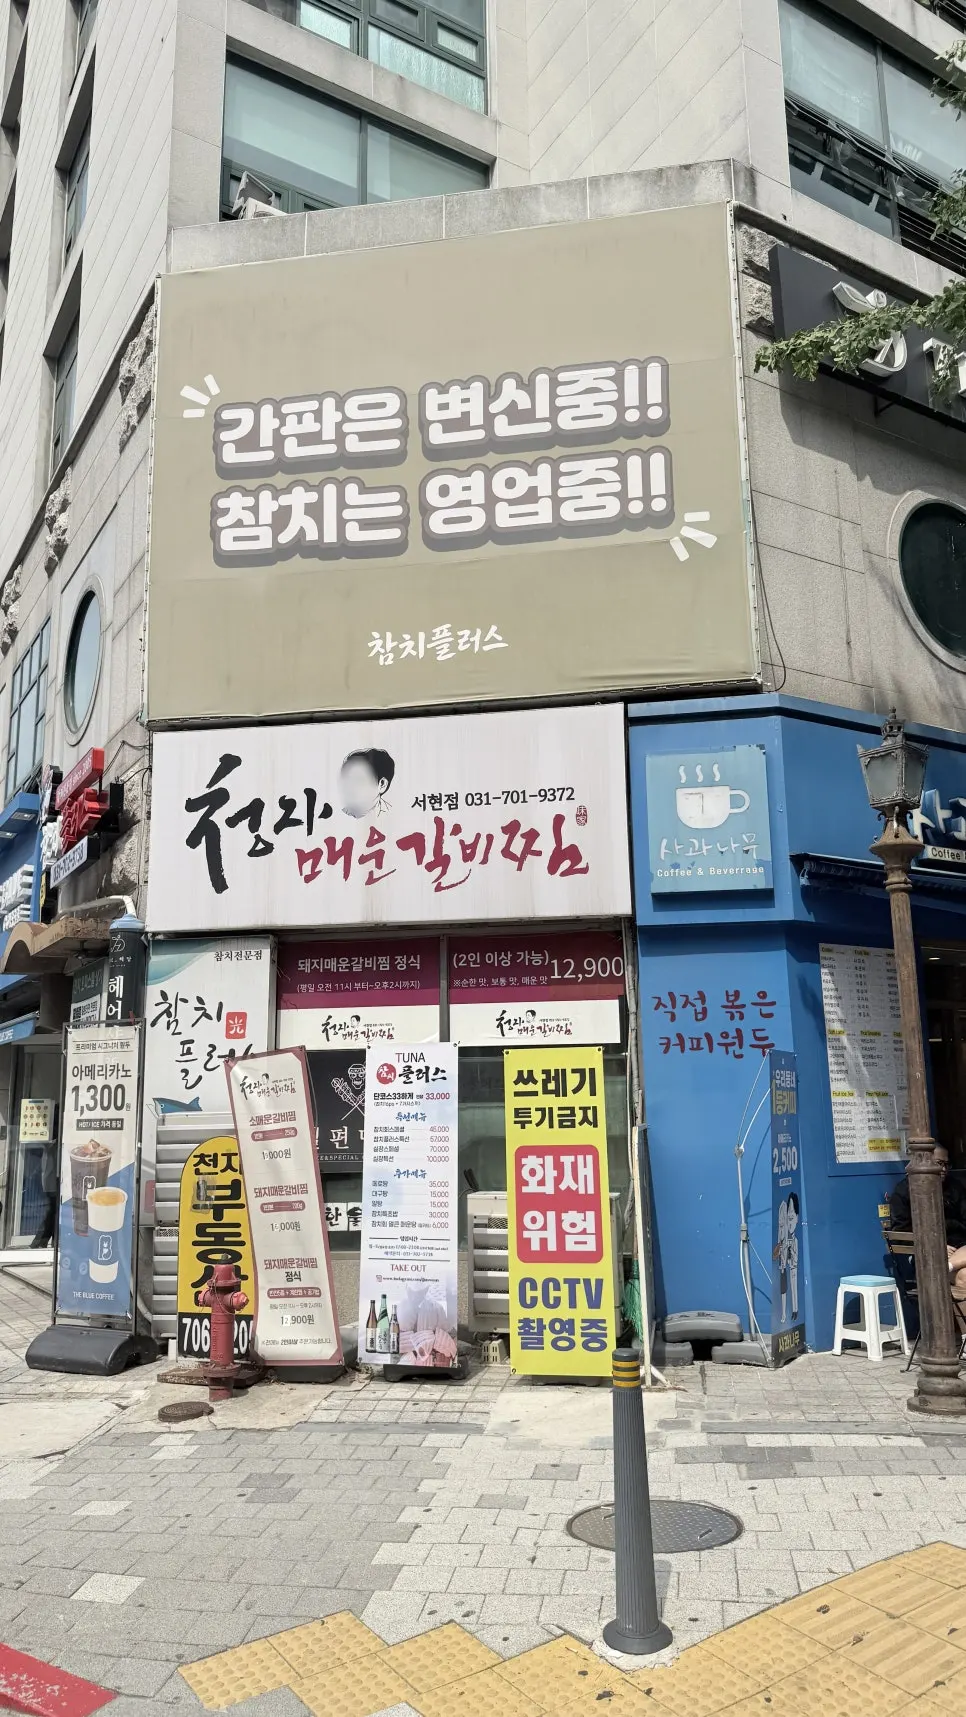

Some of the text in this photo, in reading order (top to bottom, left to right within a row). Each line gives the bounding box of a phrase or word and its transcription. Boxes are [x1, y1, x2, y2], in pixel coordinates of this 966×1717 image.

[218, 361, 664, 465] 간판은 변신중!!
[216, 451, 667, 553] 참치는 영업중!!
[367, 622, 510, 667] 참치플러스
[411, 786, 575, 812] 서현점 031-701-9372
[660, 832, 760, 861] 사과나무
[931, 847, 961, 860] Coffee
[657, 868, 692, 878] Coffee
[697, 867, 704, 876] &
[213, 949, 262, 962] 참치전문점
[297, 954, 421, 973] 돼지매운갈비찜 정식
[452, 950, 549, 968] (2인 이상 가능)
[491, 977, 507, 987] 보통
[521, 975, 538, 985] 매운
[540, 975, 548, 985] 맛
[550, 956, 624, 982] 12,900
[296, 983, 315, 993] (평일
[316, 983, 332, 992] 오전
[150, 989, 223, 1036] 참치
[651, 989, 777, 1022] 직접 볶은
[658, 1027, 776, 1060] 커피원두
[395, 1052, 426, 1063] TUNA
[72, 1062, 132, 1081] 아메리카노
[399, 1064, 448, 1085] 플러스
[512, 1067, 597, 1099] 쓰레기
[425, 1092, 451, 1100] 33,000
[512, 1105, 599, 1130] 투기금지
[772, 1145, 798, 1175] 2,500
[520, 1154, 595, 1196] 화재
[253, 1182, 309, 1198] 돼지매운갈비찜
[521, 1209, 597, 1252] 위험
[285, 1270, 302, 1282] 정식
[390, 1263, 427, 1273] TAKE OUT
[82, 1291, 95, 1299] BLUE
[95, 1292, 115, 1301] COFFEE
[517, 1276, 604, 1310] CCTV
[516, 1316, 608, 1353] 촬영중
